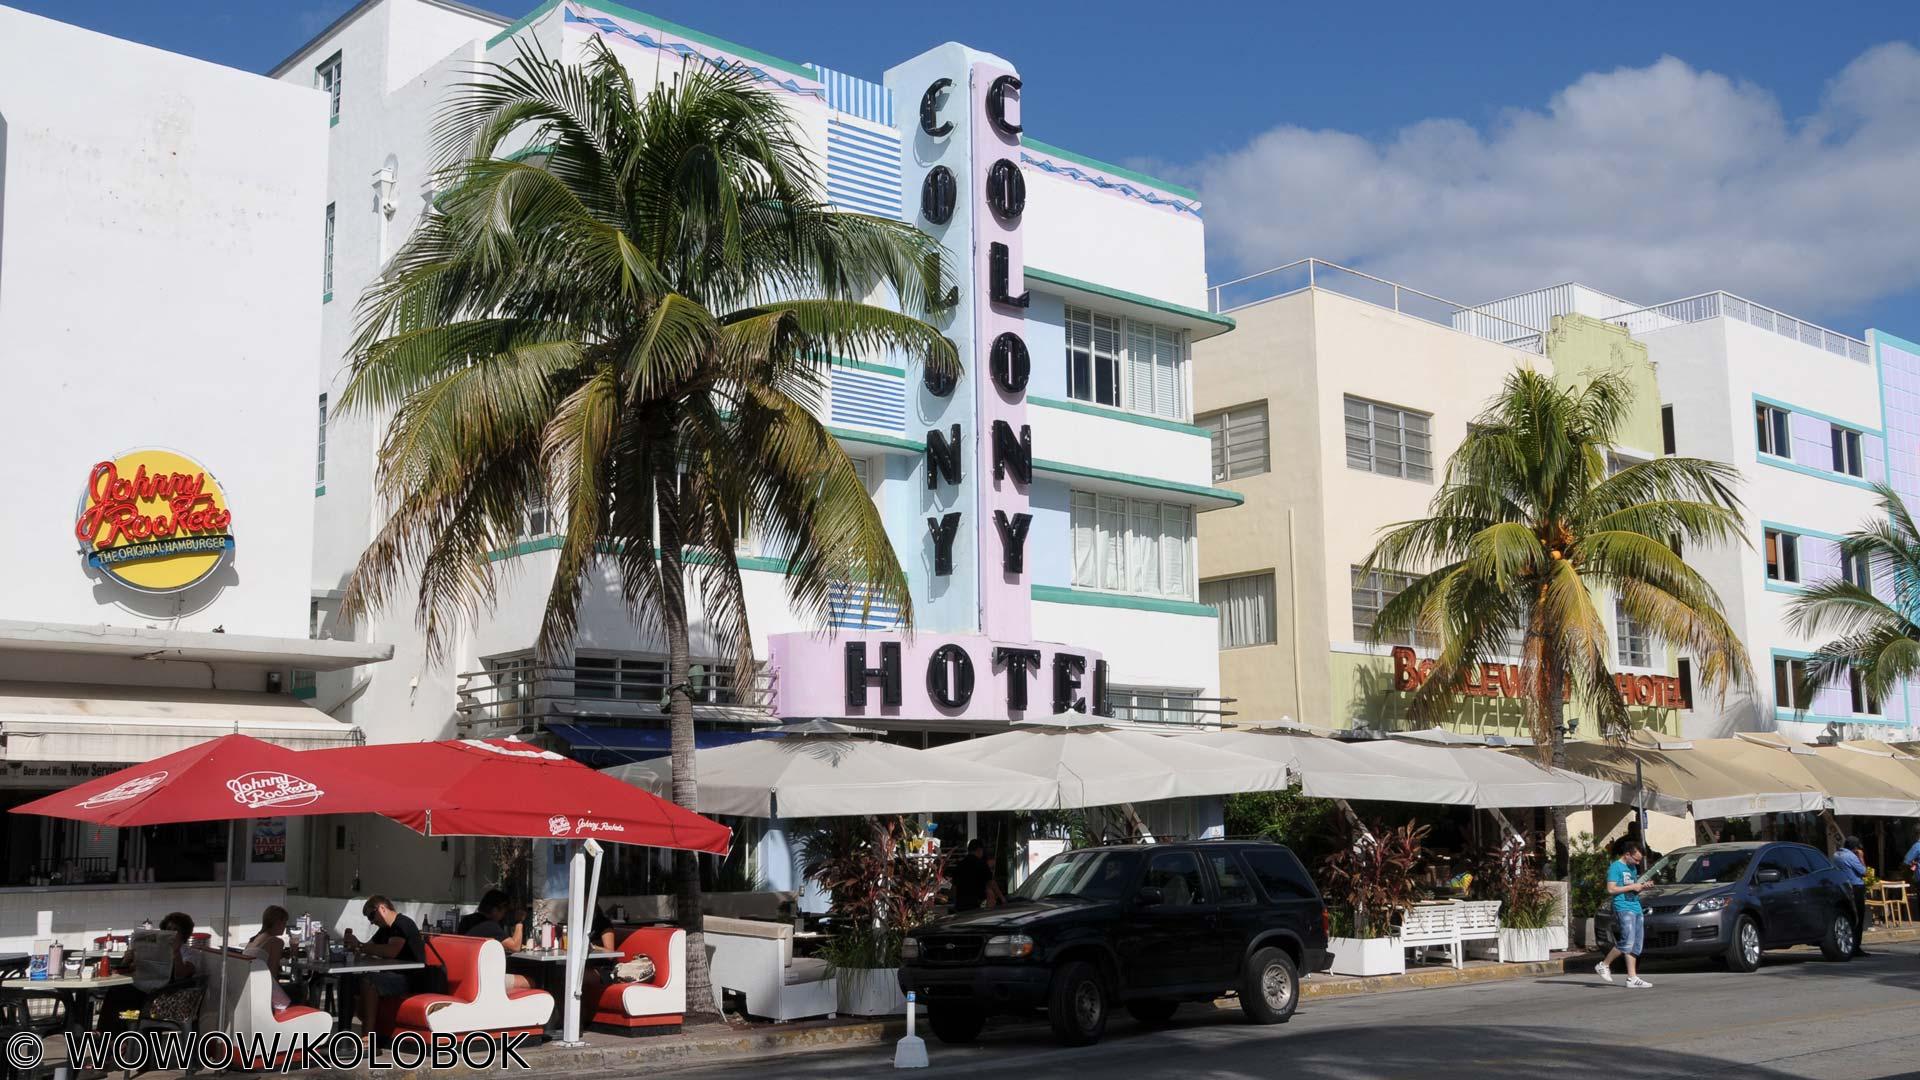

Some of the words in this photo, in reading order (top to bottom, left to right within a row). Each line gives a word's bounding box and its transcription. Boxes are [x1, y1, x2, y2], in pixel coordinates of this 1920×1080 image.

[920, 78, 961, 576] COLONY
[986, 75, 1033, 573] COLONY
[75, 461, 213, 541] Johnny
[96, 494, 231, 548] Rockets
[96, 550, 119, 563] THE
[119, 544, 163, 560] ORIGINAL
[165, 537, 226, 552] HAMBURGER
[1614, 672, 1686, 709] HOTEL
[23, 765, 39, 776] Beer
[39, 765, 51, 776] and
[52, 765, 67, 776] Wine
[70, 763, 90, 777] Now
[226, 774, 300, 803] Johnny
